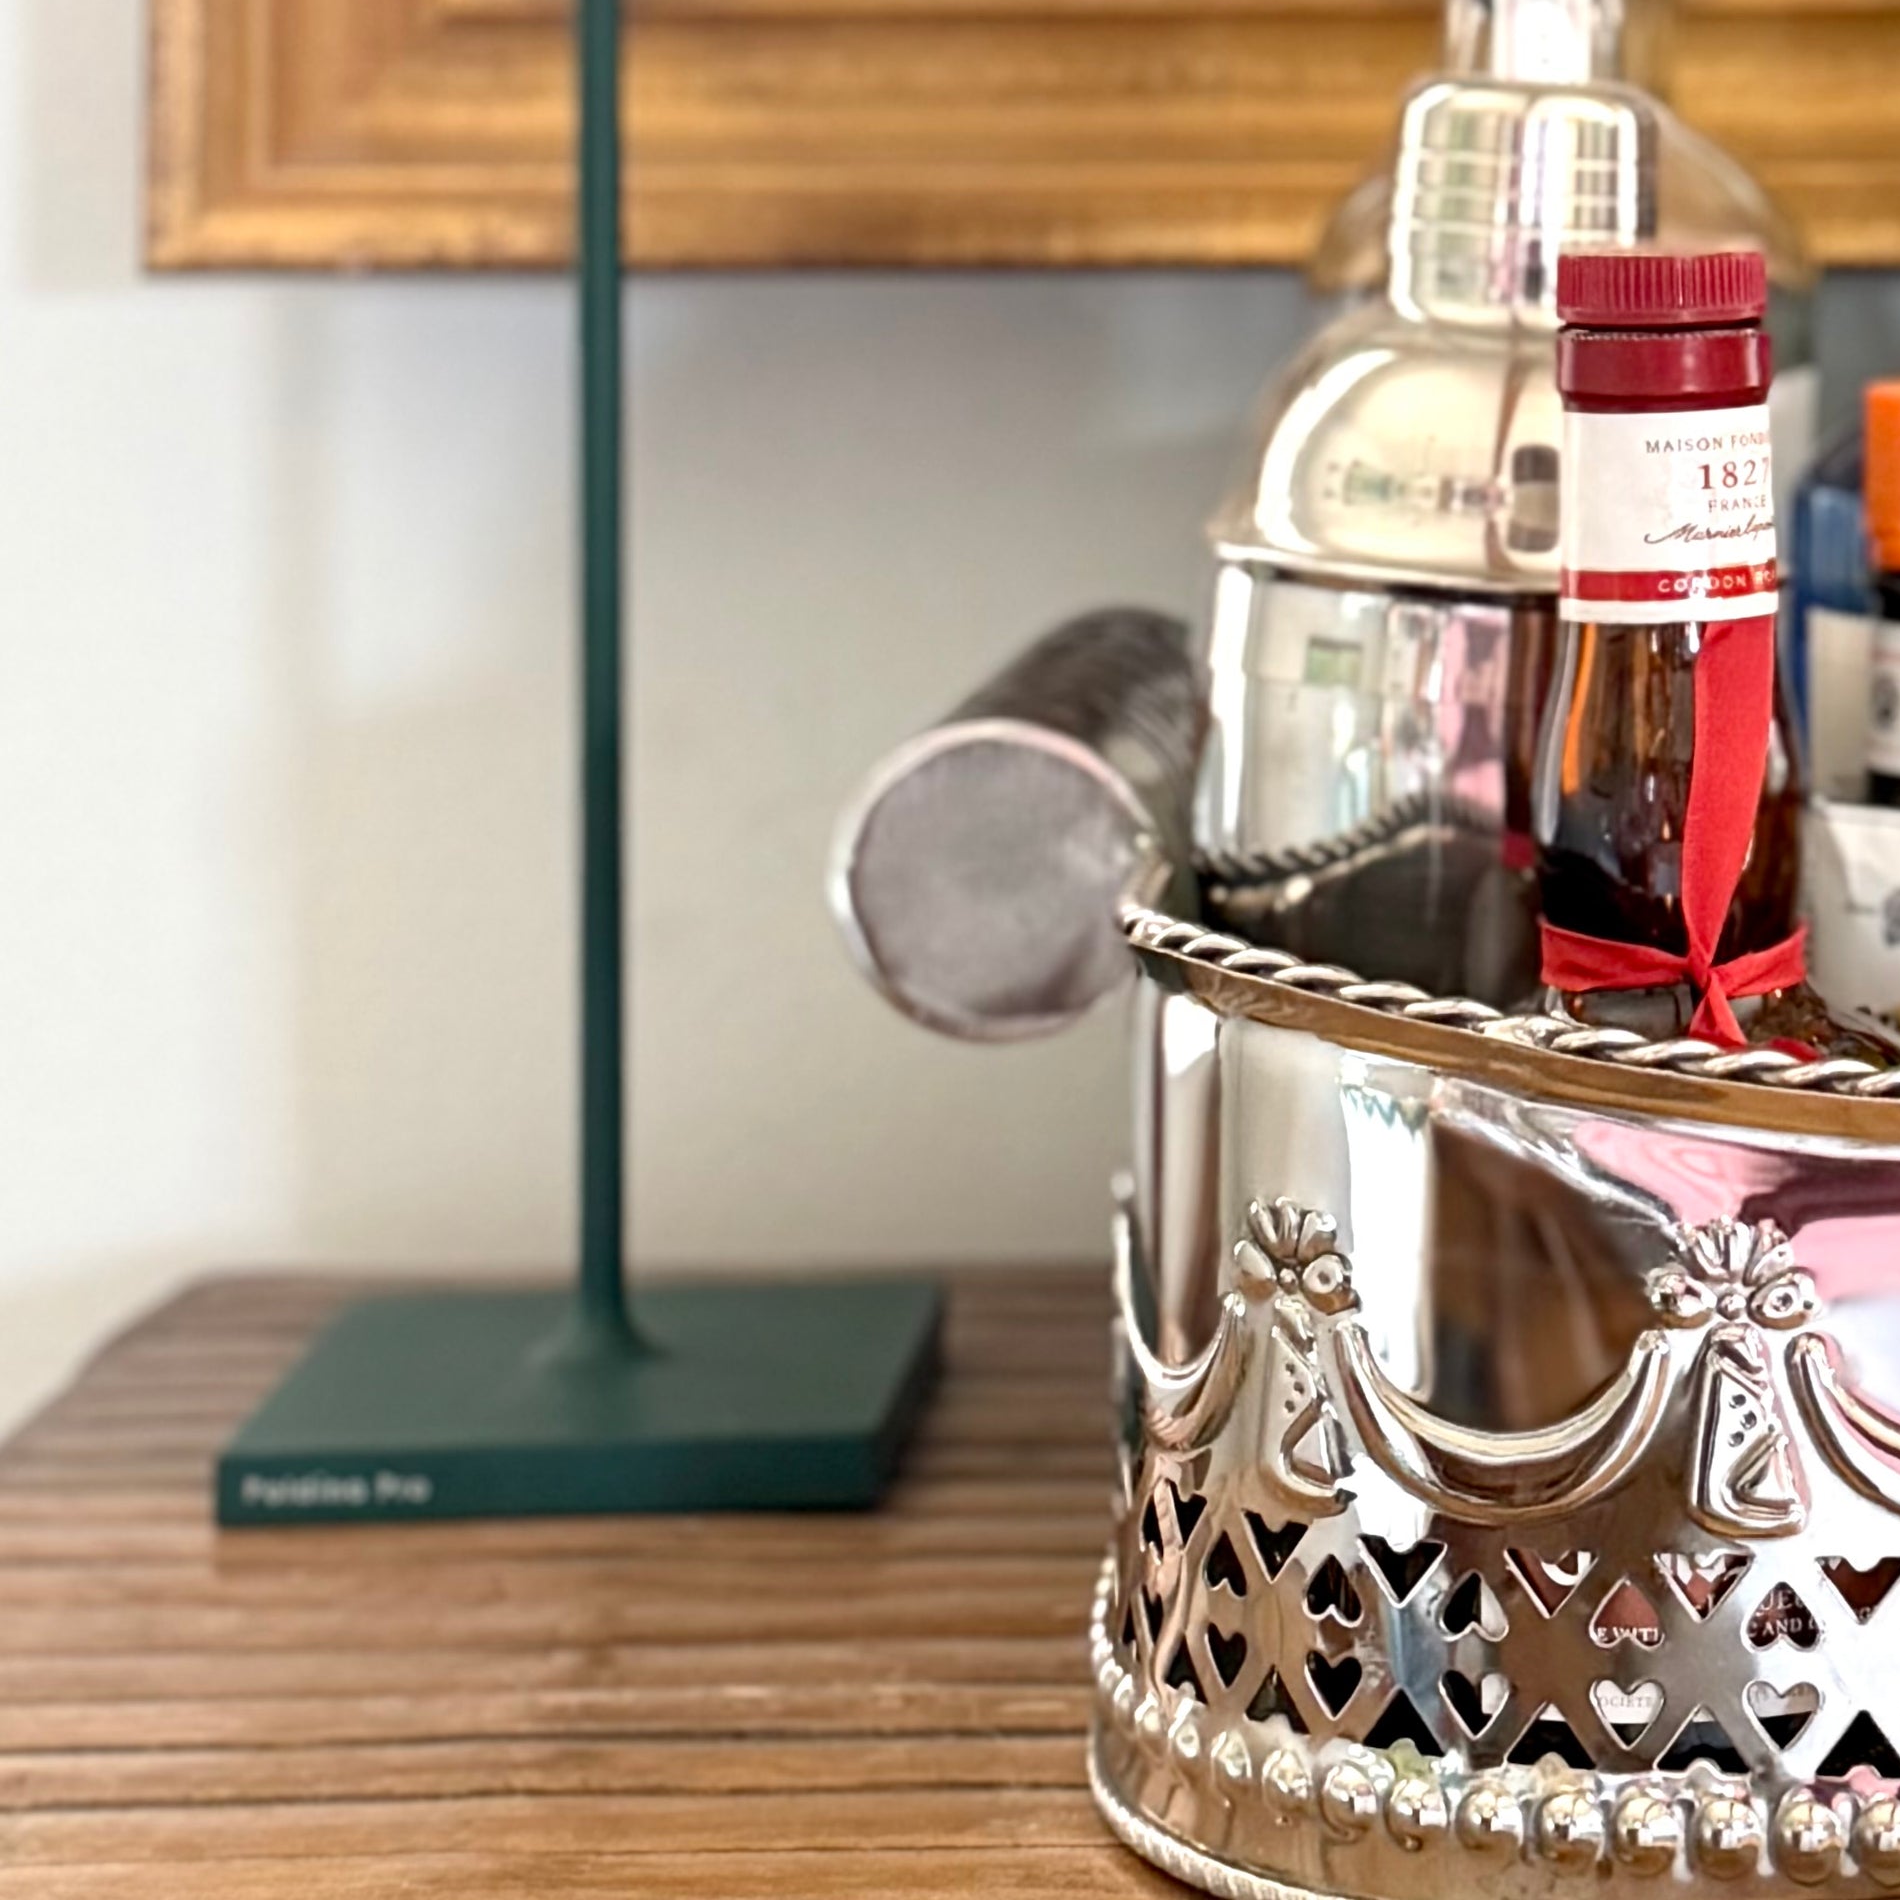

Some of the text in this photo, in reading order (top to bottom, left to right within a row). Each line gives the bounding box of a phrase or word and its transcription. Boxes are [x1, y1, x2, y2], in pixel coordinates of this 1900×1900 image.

[1645, 437, 1723, 454] MAISON
[1699, 457, 1769, 490] 1827
[1708, 494, 1767, 513] FRANCE
[1762, 1617, 1803, 1637] AND
